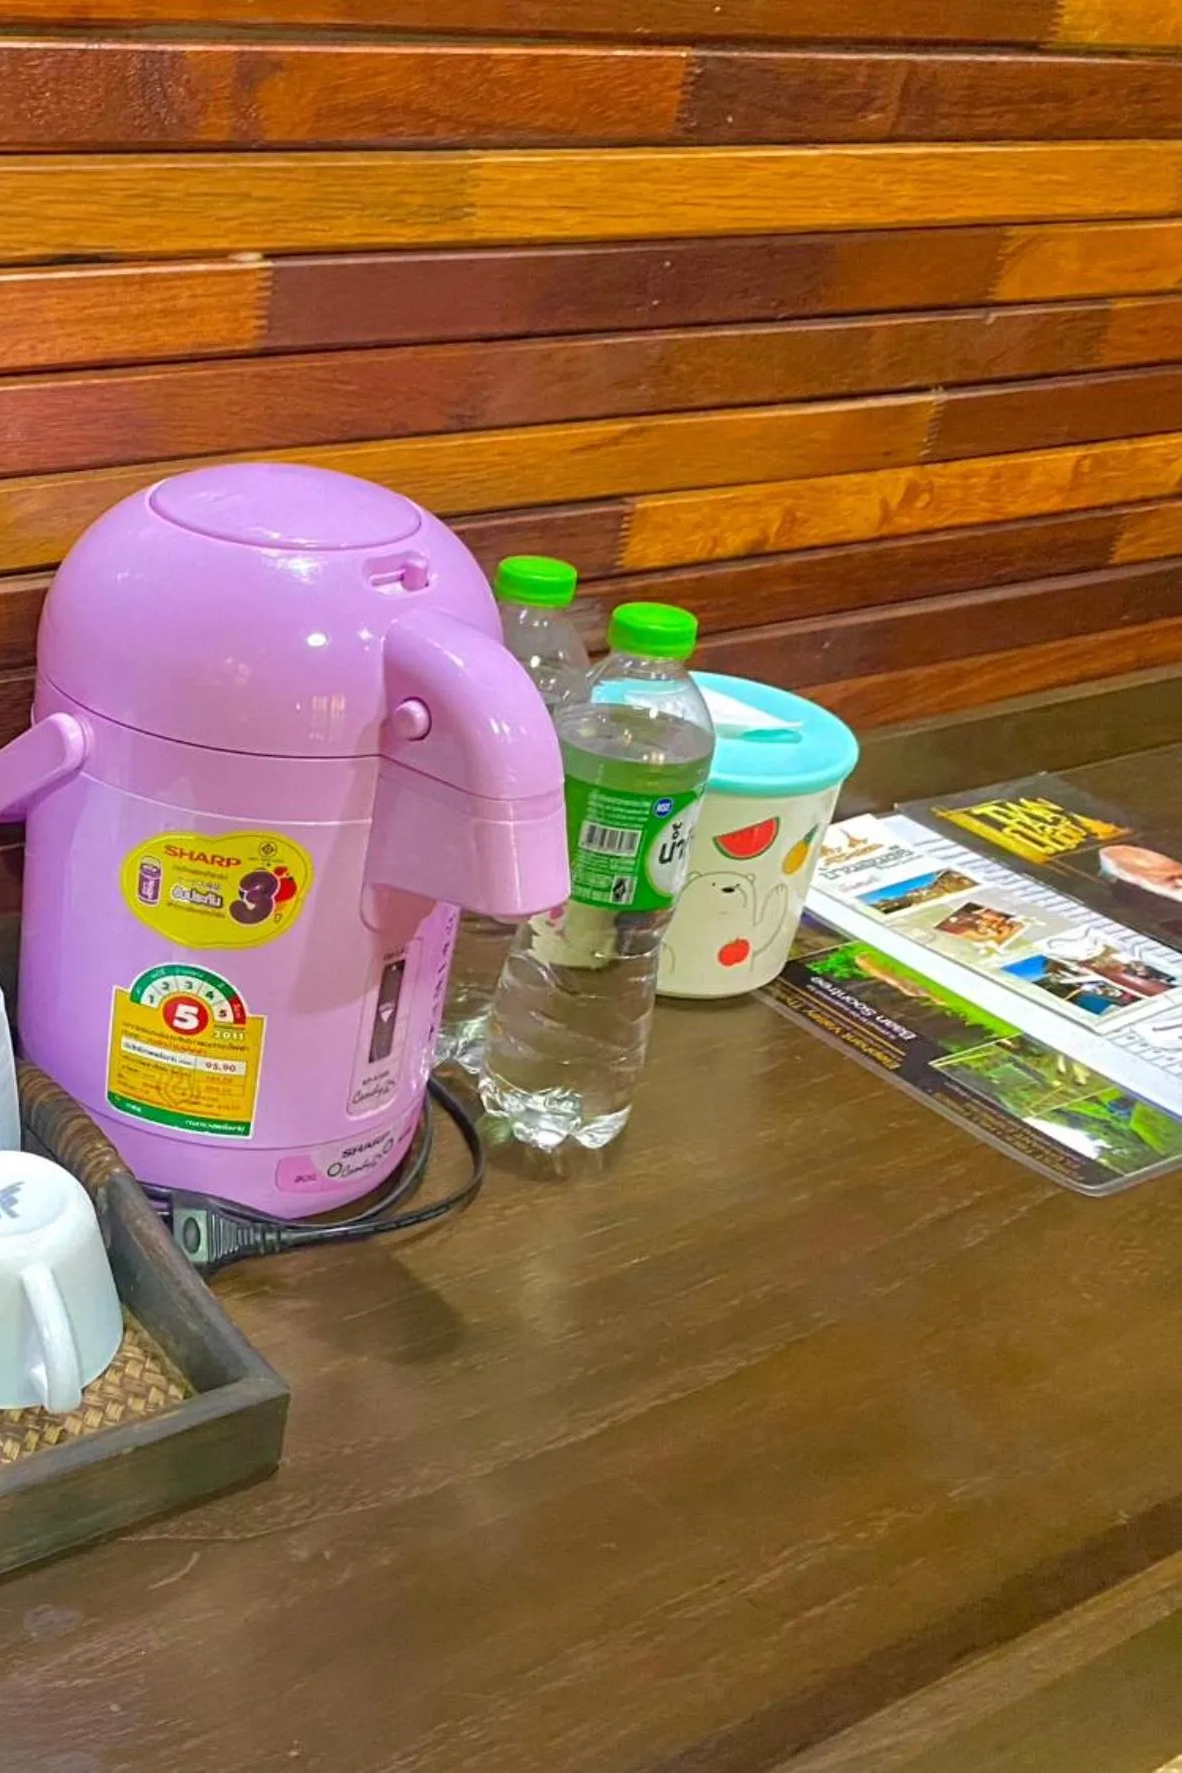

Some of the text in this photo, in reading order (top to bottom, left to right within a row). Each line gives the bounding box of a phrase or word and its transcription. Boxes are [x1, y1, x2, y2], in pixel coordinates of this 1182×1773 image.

[163, 844, 242, 868] SHARP
[148, 994, 155, 1004] 1
[161, 981, 170, 990] 2
[184, 980, 193, 990] 3
[205, 990, 214, 1000] 4
[219, 1009, 228, 1018] 5
[172, 1003, 200, 1030] 5
[214, 1030, 244, 1041] 2011
